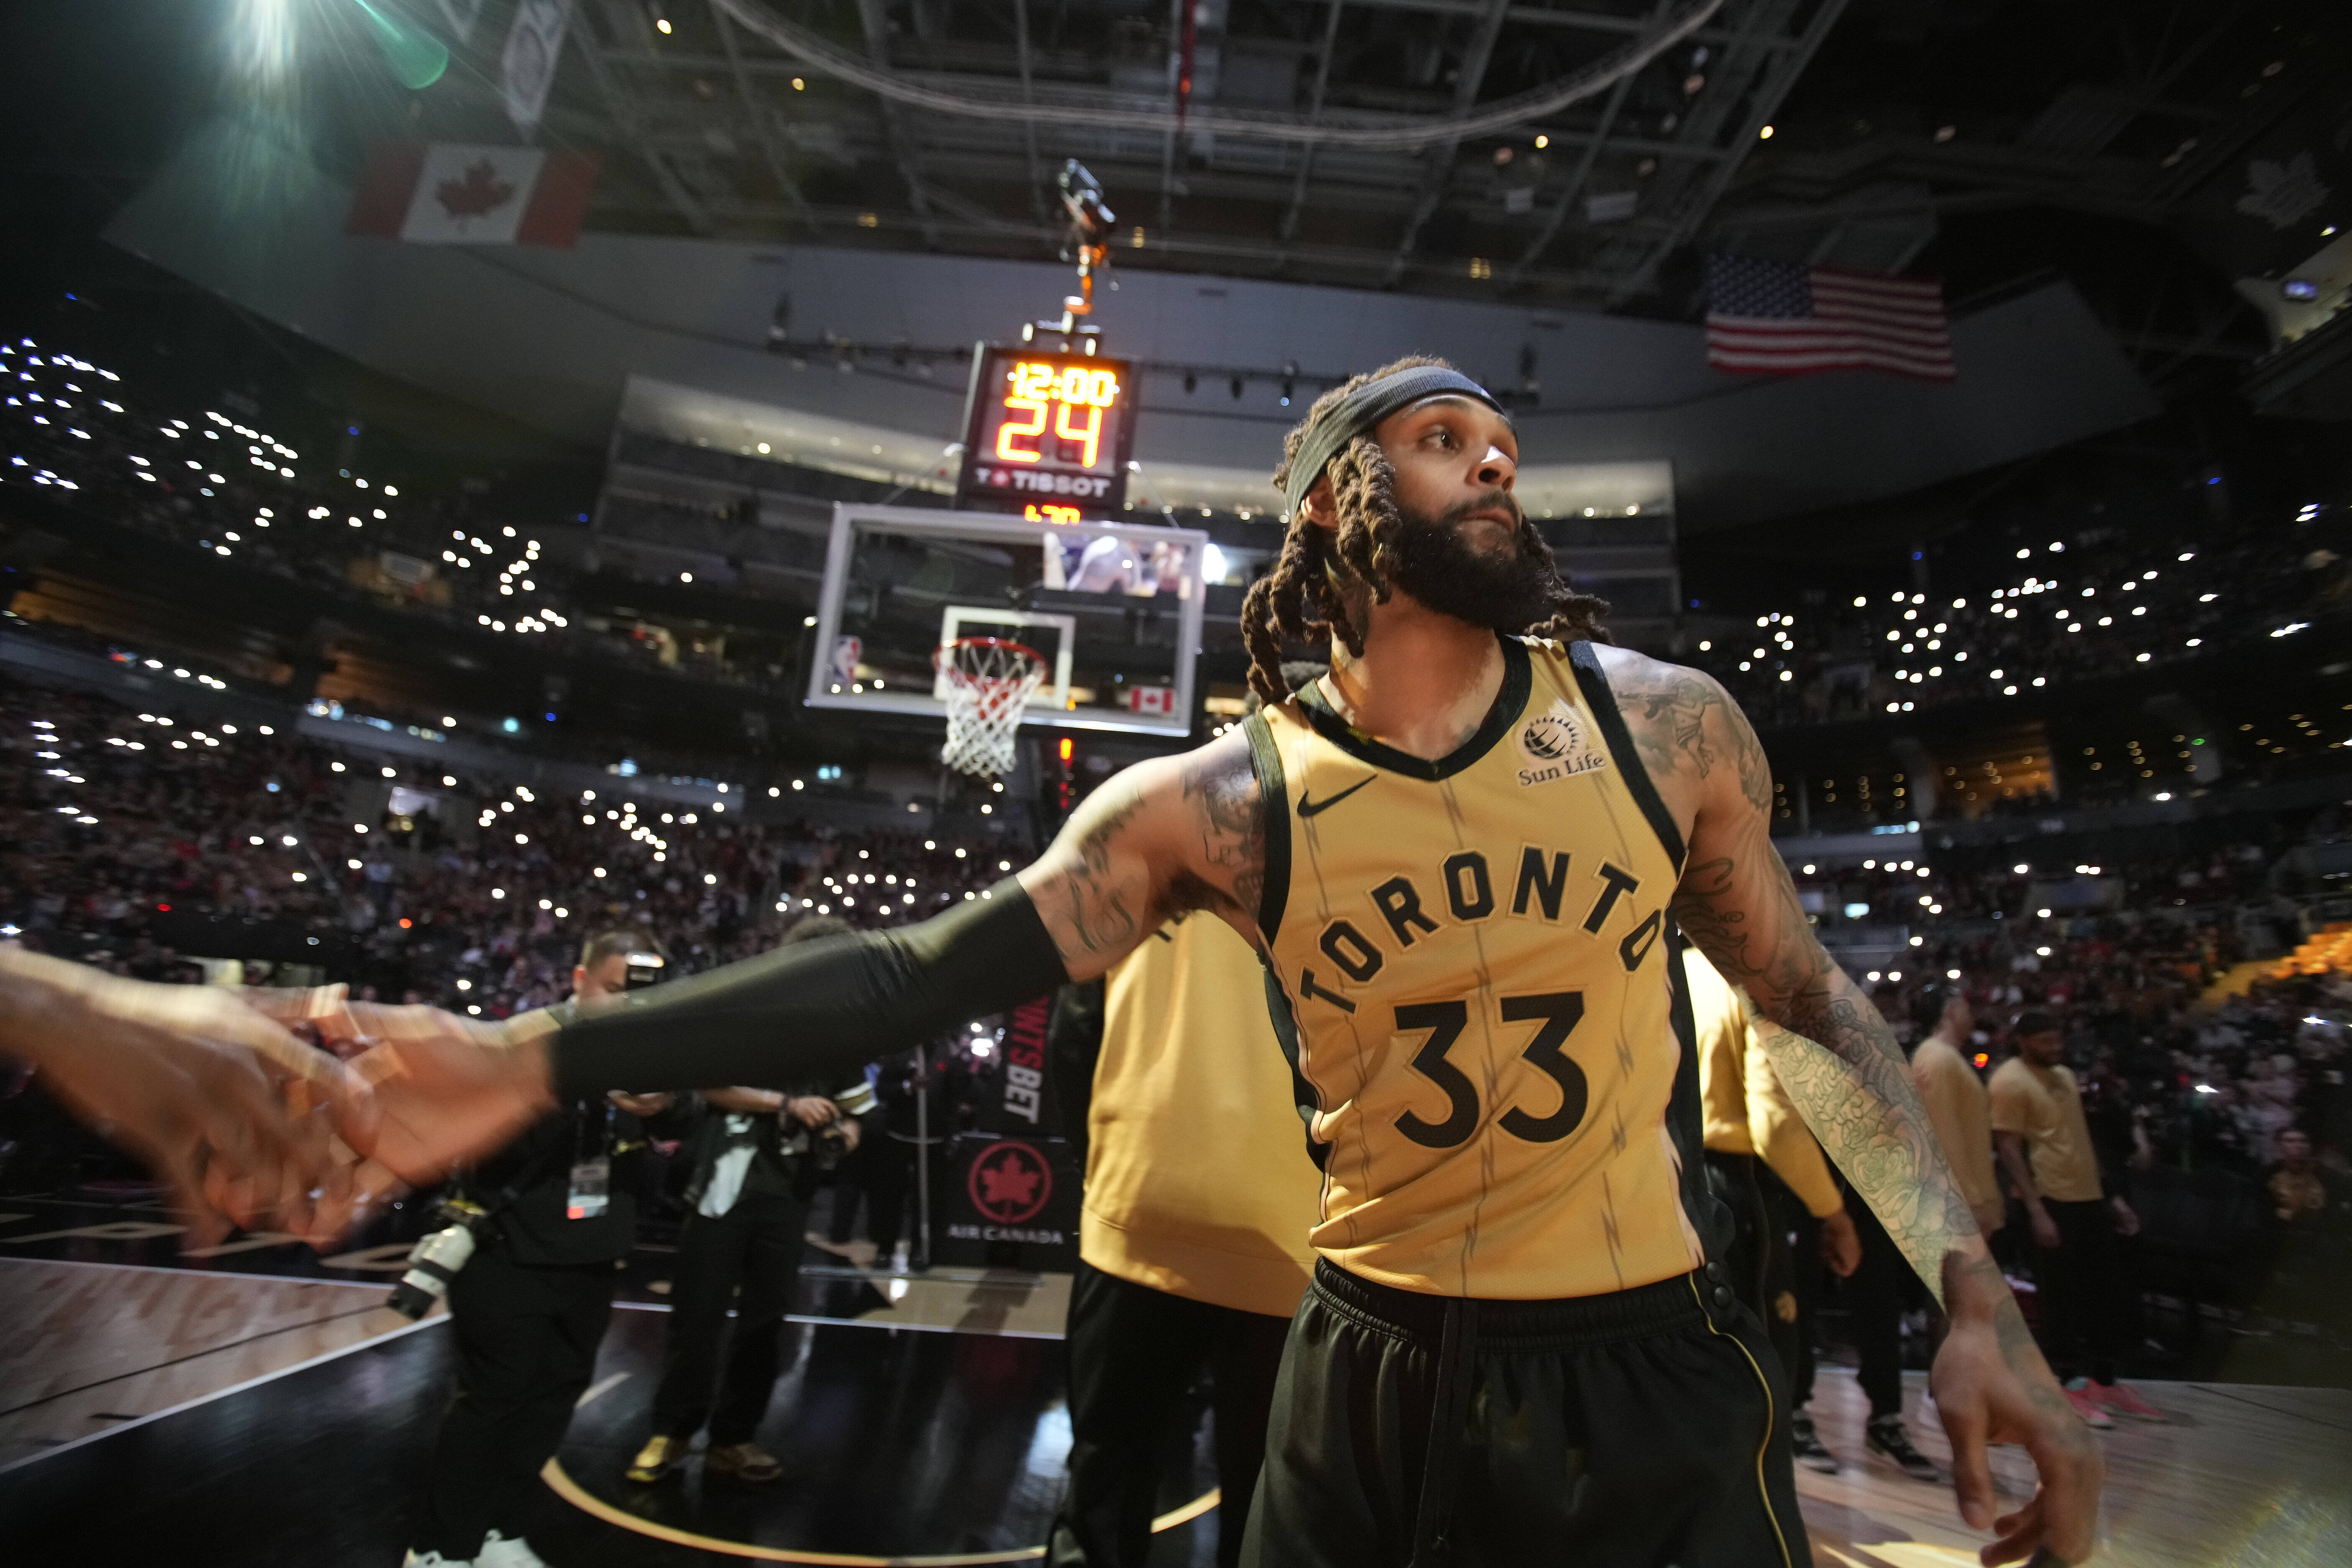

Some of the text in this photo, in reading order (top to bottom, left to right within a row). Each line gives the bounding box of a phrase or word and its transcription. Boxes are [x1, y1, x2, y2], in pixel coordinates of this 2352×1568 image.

[1013, 362, 1116, 407] 12:00
[996, 396, 1102, 468] 24
[1012, 469, 1110, 498] TISSOT
[1519, 753, 1606, 786] Sun Life
[1300, 845, 1661, 1014] TORONTO
[1394, 991, 1588, 1148] 33
[948, 1223, 1064, 1245] AIR CANADA
